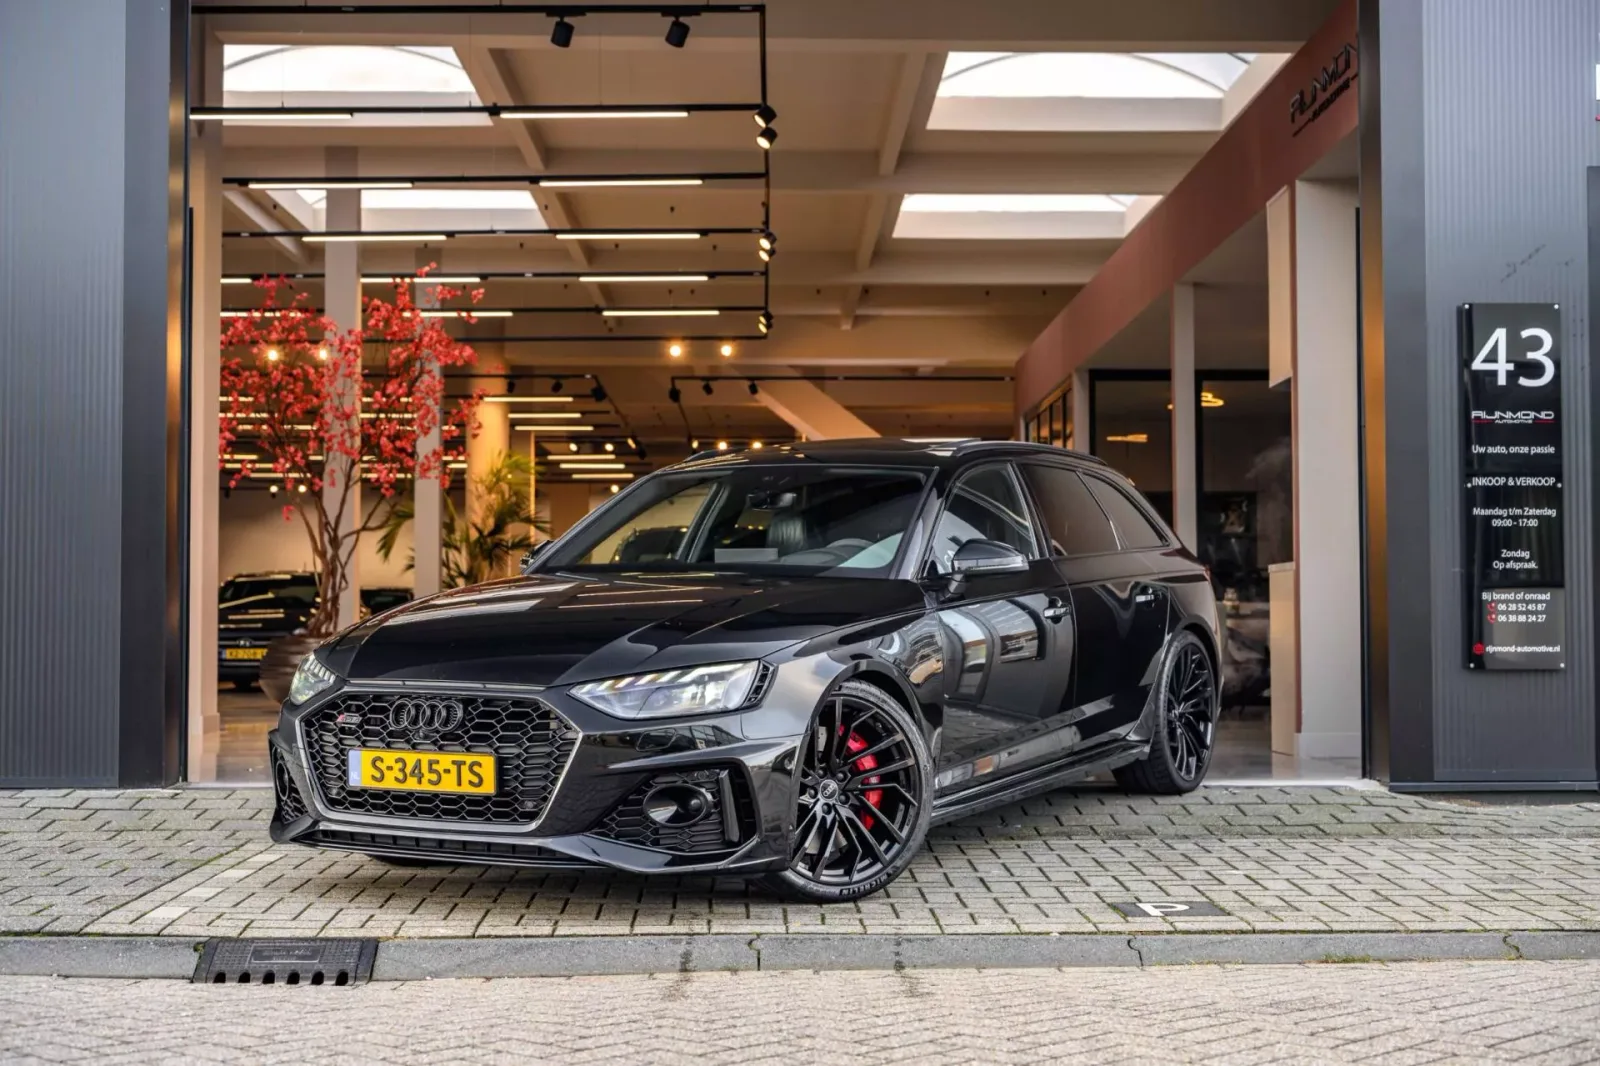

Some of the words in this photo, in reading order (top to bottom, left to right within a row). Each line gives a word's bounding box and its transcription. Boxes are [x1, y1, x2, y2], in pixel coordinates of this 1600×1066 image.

[1471, 327, 1555, 387] 43
[1471, 410, 1555, 419] RIJNMOND
[1472, 444, 1486, 453] Uw
[1487, 445, 1508, 454] auto,
[1509, 446, 1529, 454] onze
[1530, 444, 1555, 455] passie
[1472, 477, 1506, 486] INKOOP
[1507, 477, 1515, 486] &
[1516, 477, 1556, 486] VERKOOP
[1473, 507, 1508, 517] Maandag
[1509, 507, 1522, 516] t/m
[1524, 507, 1556, 517] Zaterdag
[1492, 519, 1513, 527] 09:00
[1518, 519, 1539, 527] 17:00
[1501, 549, 1530, 559] Zondag
[1493, 560, 1505, 570] Op
[1506, 560, 1539, 570] afspraak.
[1482, 592, 1492, 601] Bij
[1493, 592, 1515, 600] brand
[1516, 592, 1524, 600] of
[1524, 592, 1551, 600] onraad
[1497, 603, 1507, 611] 06
[1508, 603, 1517, 611] 28
[1518, 603, 1527, 611] 52
[1527, 603, 1536, 611] 45
[1537, 603, 1546, 611] 87
[1497, 614, 1507, 622] 06
[1508, 614, 1517, 622] 38
[1518, 614, 1527, 622] 88
[1527, 614, 1536, 622] 24
[1537, 614, 1546, 622] 27
[1485, 644, 1561, 654] rijnmond-automotive.nl
[370, 755, 484, 788] S-345-TS
[842, 873, 888, 895] MICHELIN
[1135, 902, 1190, 917] P
